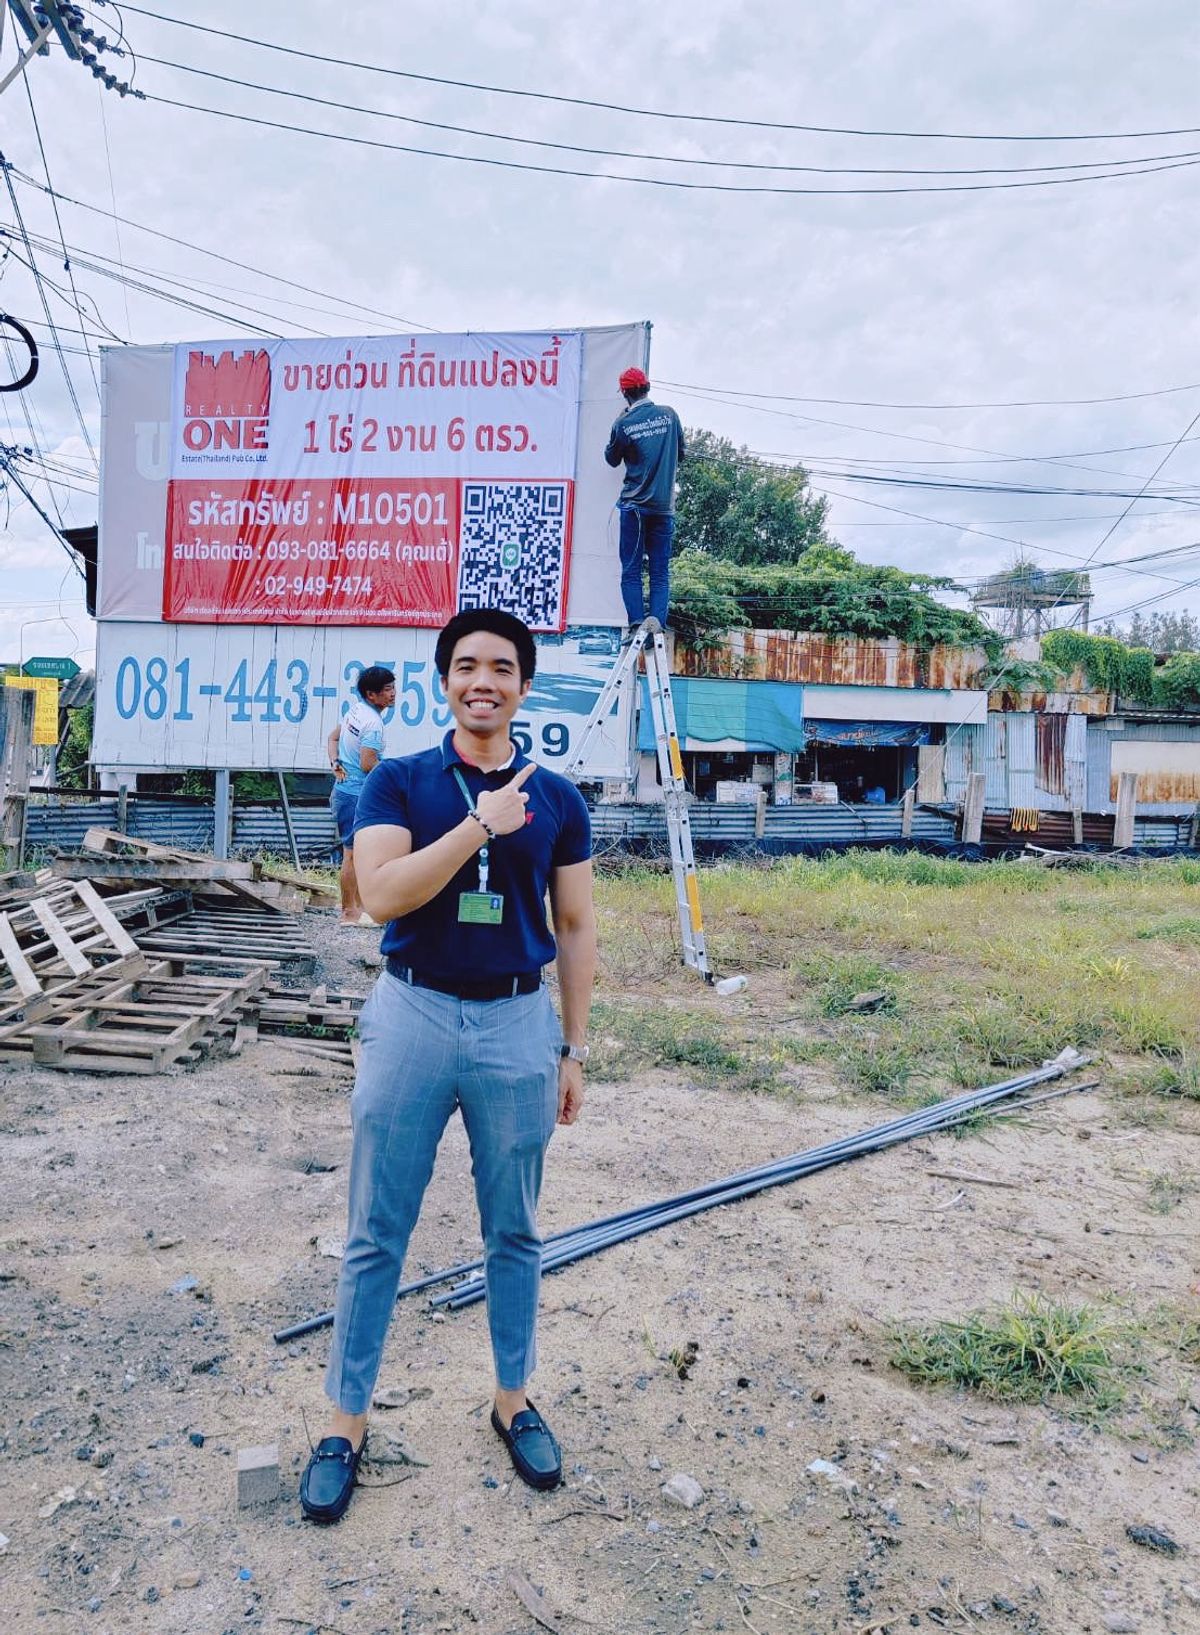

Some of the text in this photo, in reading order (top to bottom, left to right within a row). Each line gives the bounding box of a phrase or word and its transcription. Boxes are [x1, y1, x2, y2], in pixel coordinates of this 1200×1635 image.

[283, 336, 562, 391] ขายด่วน ที่ดินแปลงนี้
[184, 403, 268, 416] REALTY
[183, 418, 270, 451] ONE
[303, 414, 538, 453] 1 ไร่ 2 งาน 6 ตรว.
[188, 490, 311, 526] รหัสทรัพย์
[333, 492, 448, 525] M10501
[173, 537, 253, 560] สนใจติดต่อ
[266, 540, 391, 560] 093-081-6664
[395, 538, 453, 567] (คุณเต้)
[264, 576, 373, 596] 02-949-7474
